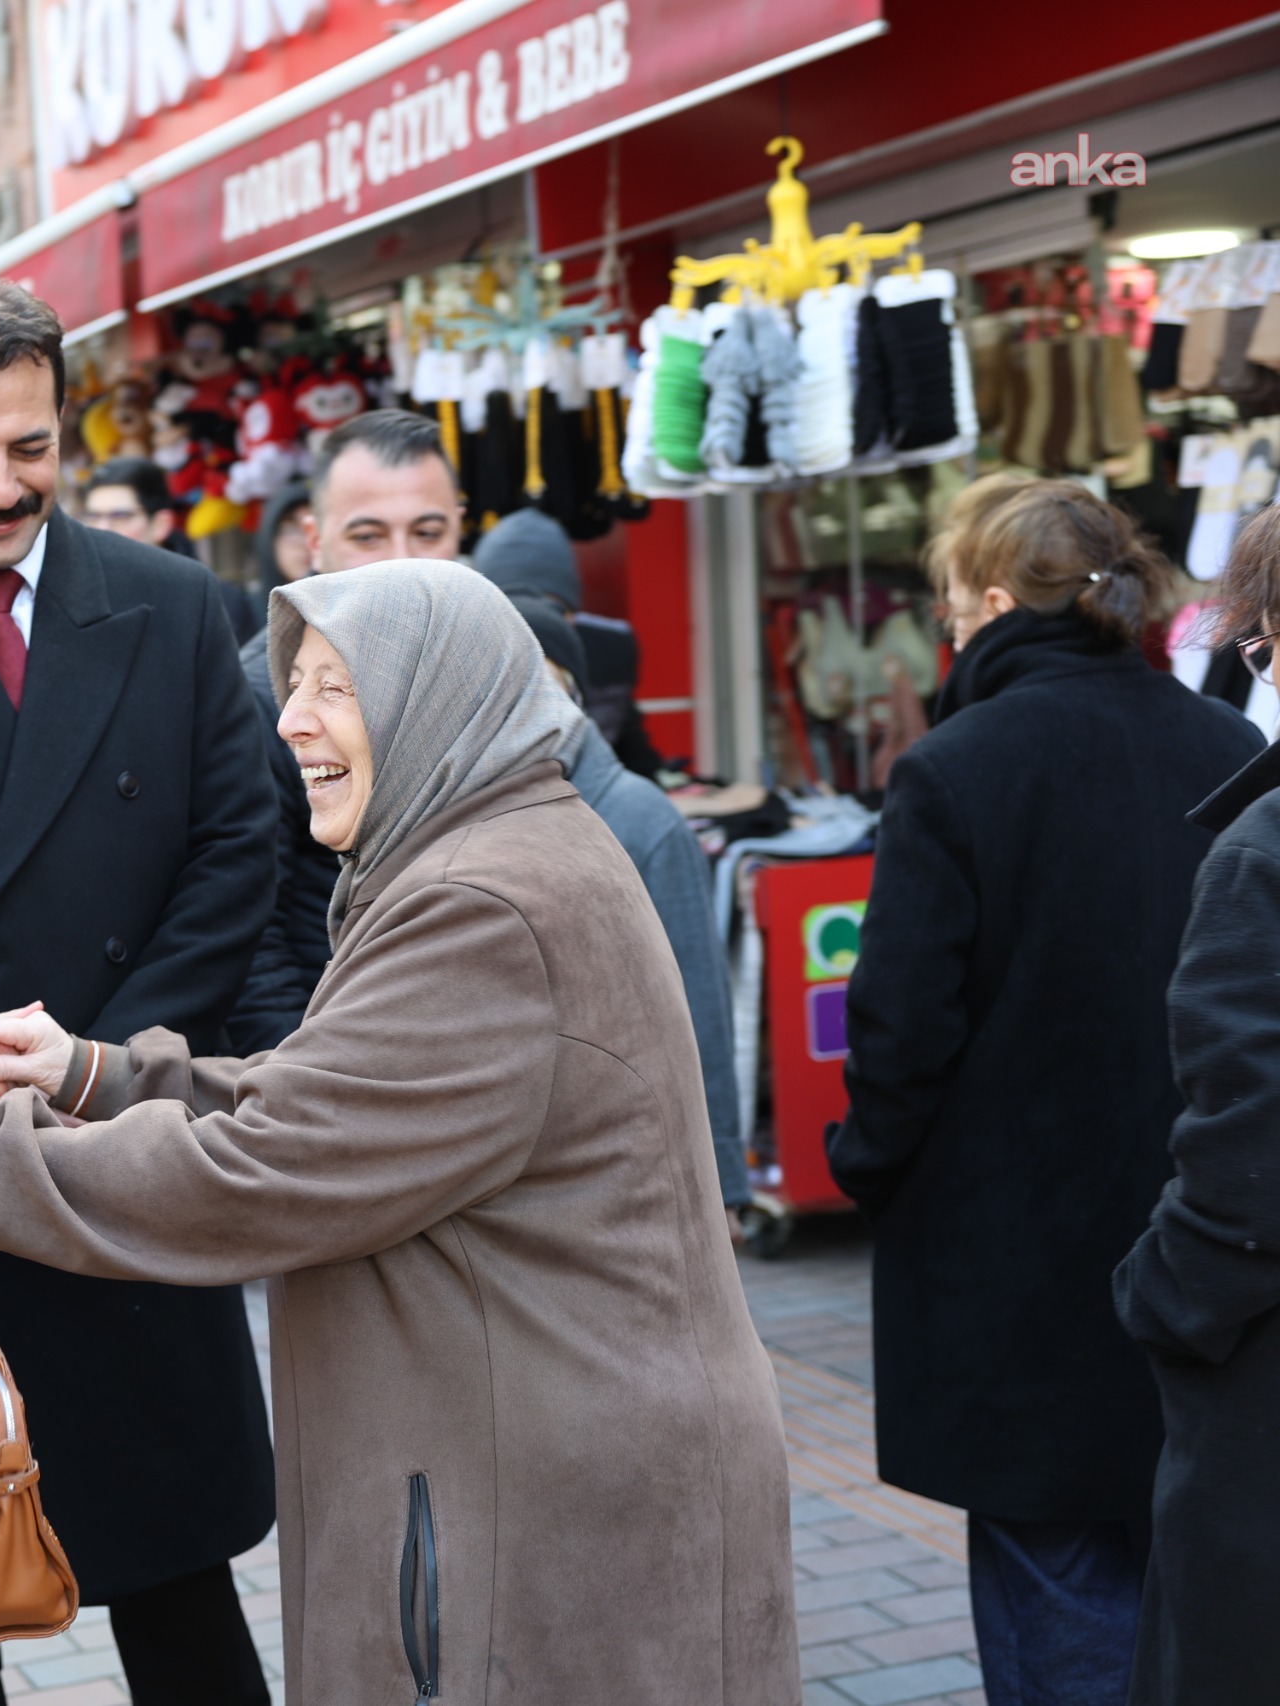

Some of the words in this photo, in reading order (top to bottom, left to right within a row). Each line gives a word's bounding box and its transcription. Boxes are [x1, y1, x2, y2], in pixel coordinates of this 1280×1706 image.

[326, 111, 363, 214] İÇ
[365, 65, 471, 185] GİYİM
[475, 49, 508, 140] &
[516, 0, 630, 124] BEBE
